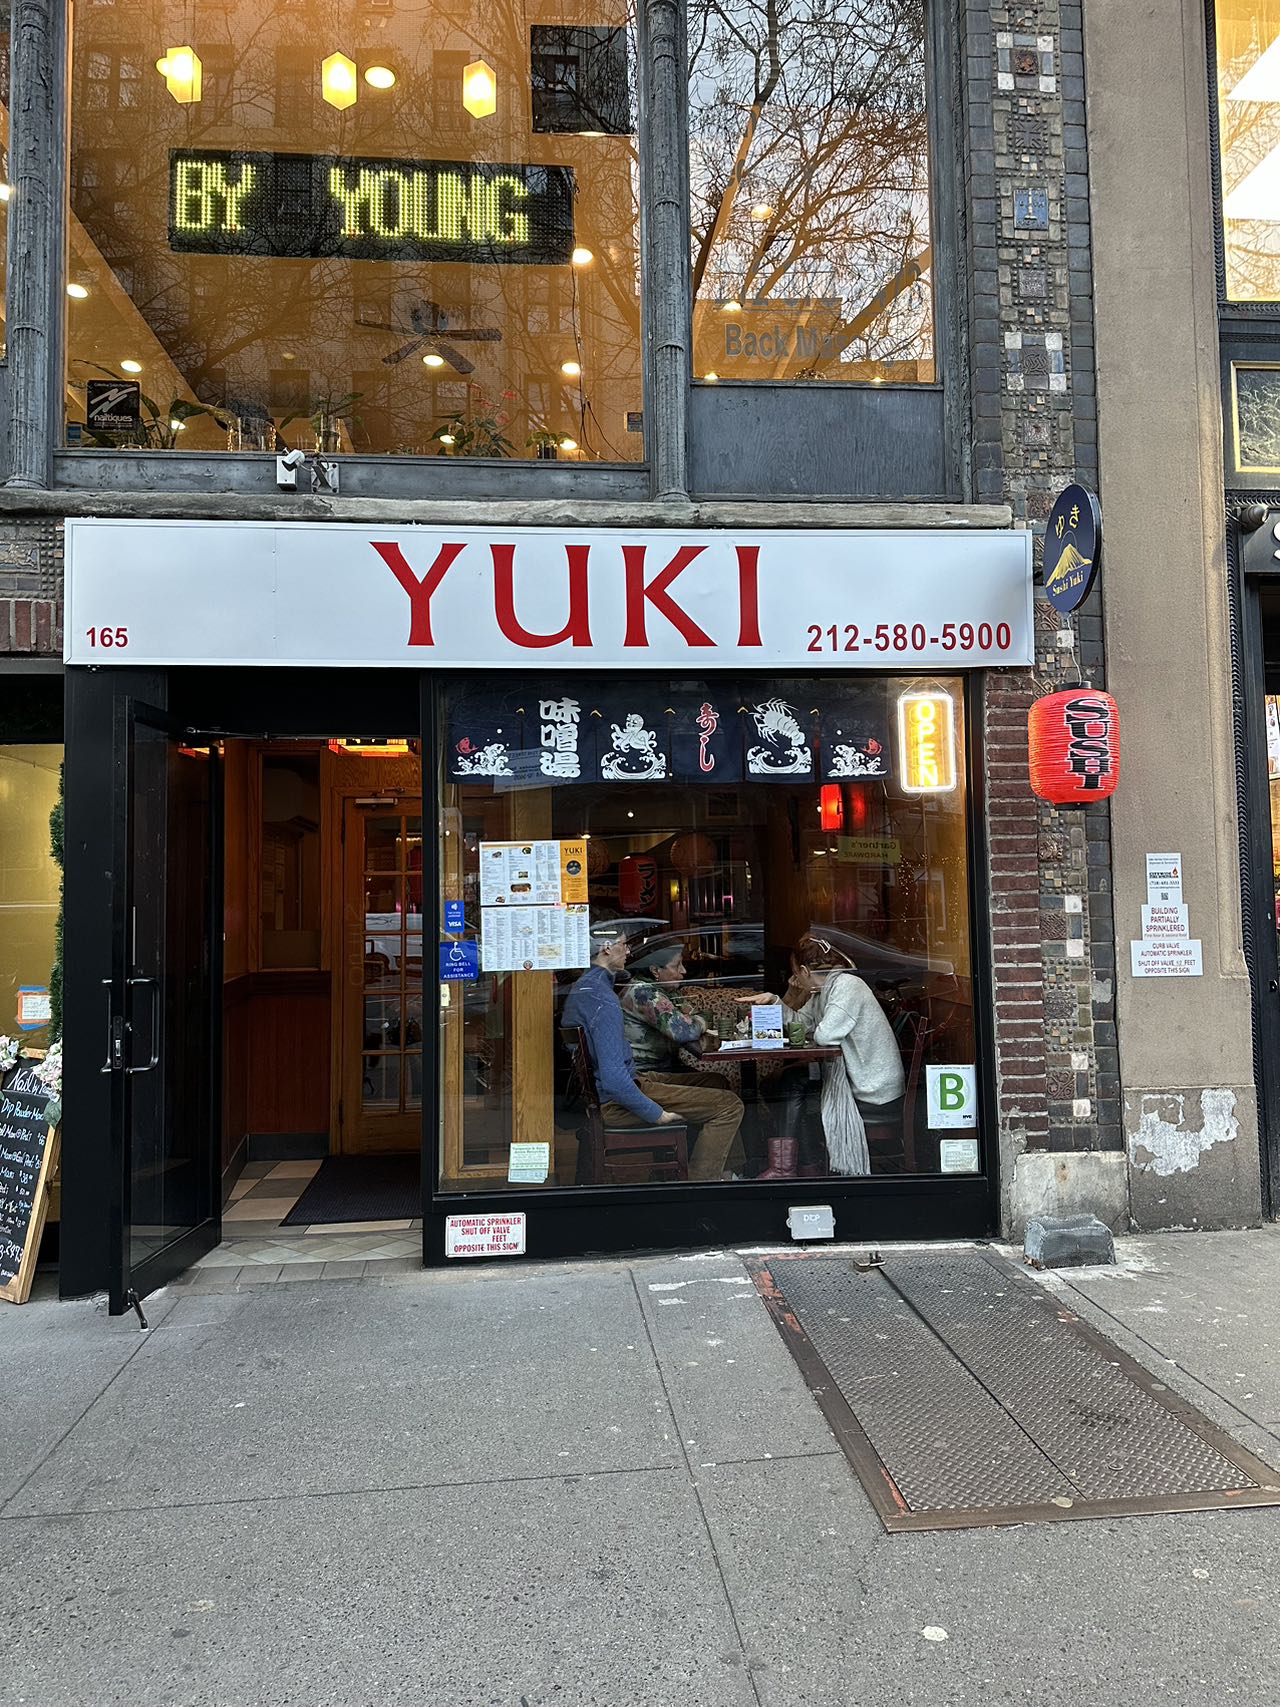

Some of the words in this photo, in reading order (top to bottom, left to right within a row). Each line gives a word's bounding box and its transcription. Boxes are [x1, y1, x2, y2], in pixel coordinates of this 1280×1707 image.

[175, 160, 257, 231] BY
[330, 166, 530, 242] YOUNG
[724, 322, 789, 358] Back
[1052, 579, 1069, 597] Sushi
[1069, 570, 1085, 588] Yuki
[369, 541, 764, 649] YUKI
[86, 626, 129, 648] 165
[806, 622, 1012, 653] 212-580-5900
[915, 699, 939, 787] OPEN
[1064, 697, 1114, 791] SUSHI
[564, 846, 584, 855] YUKI
[1146, 924, 1185, 932] SPRINKLERED
[1140, 949, 1167, 957] AUTOMATIC
[1167, 949, 1193, 957] SPRINKLER
[1167, 966, 1179, 974] THIS
[7, 1068, 34, 1093] Nail
[939, 1072, 965, 1111] B
[1, 1097, 15, 1119] Dip
[450, 1219, 486, 1227] AUTOMATIC
[487, 1217, 522, 1226] SPRINKLER
[461, 1227, 477, 1235] SHUT
[480, 1226, 491, 1234] OFF
[492, 1226, 510, 1234] VALVE
[454, 1244, 485, 1252] OPPOSITE
[487, 1242, 501, 1251] THIS
[502, 1242, 519, 1250] SIGN
[492, 1234, 507, 1242] FEET
